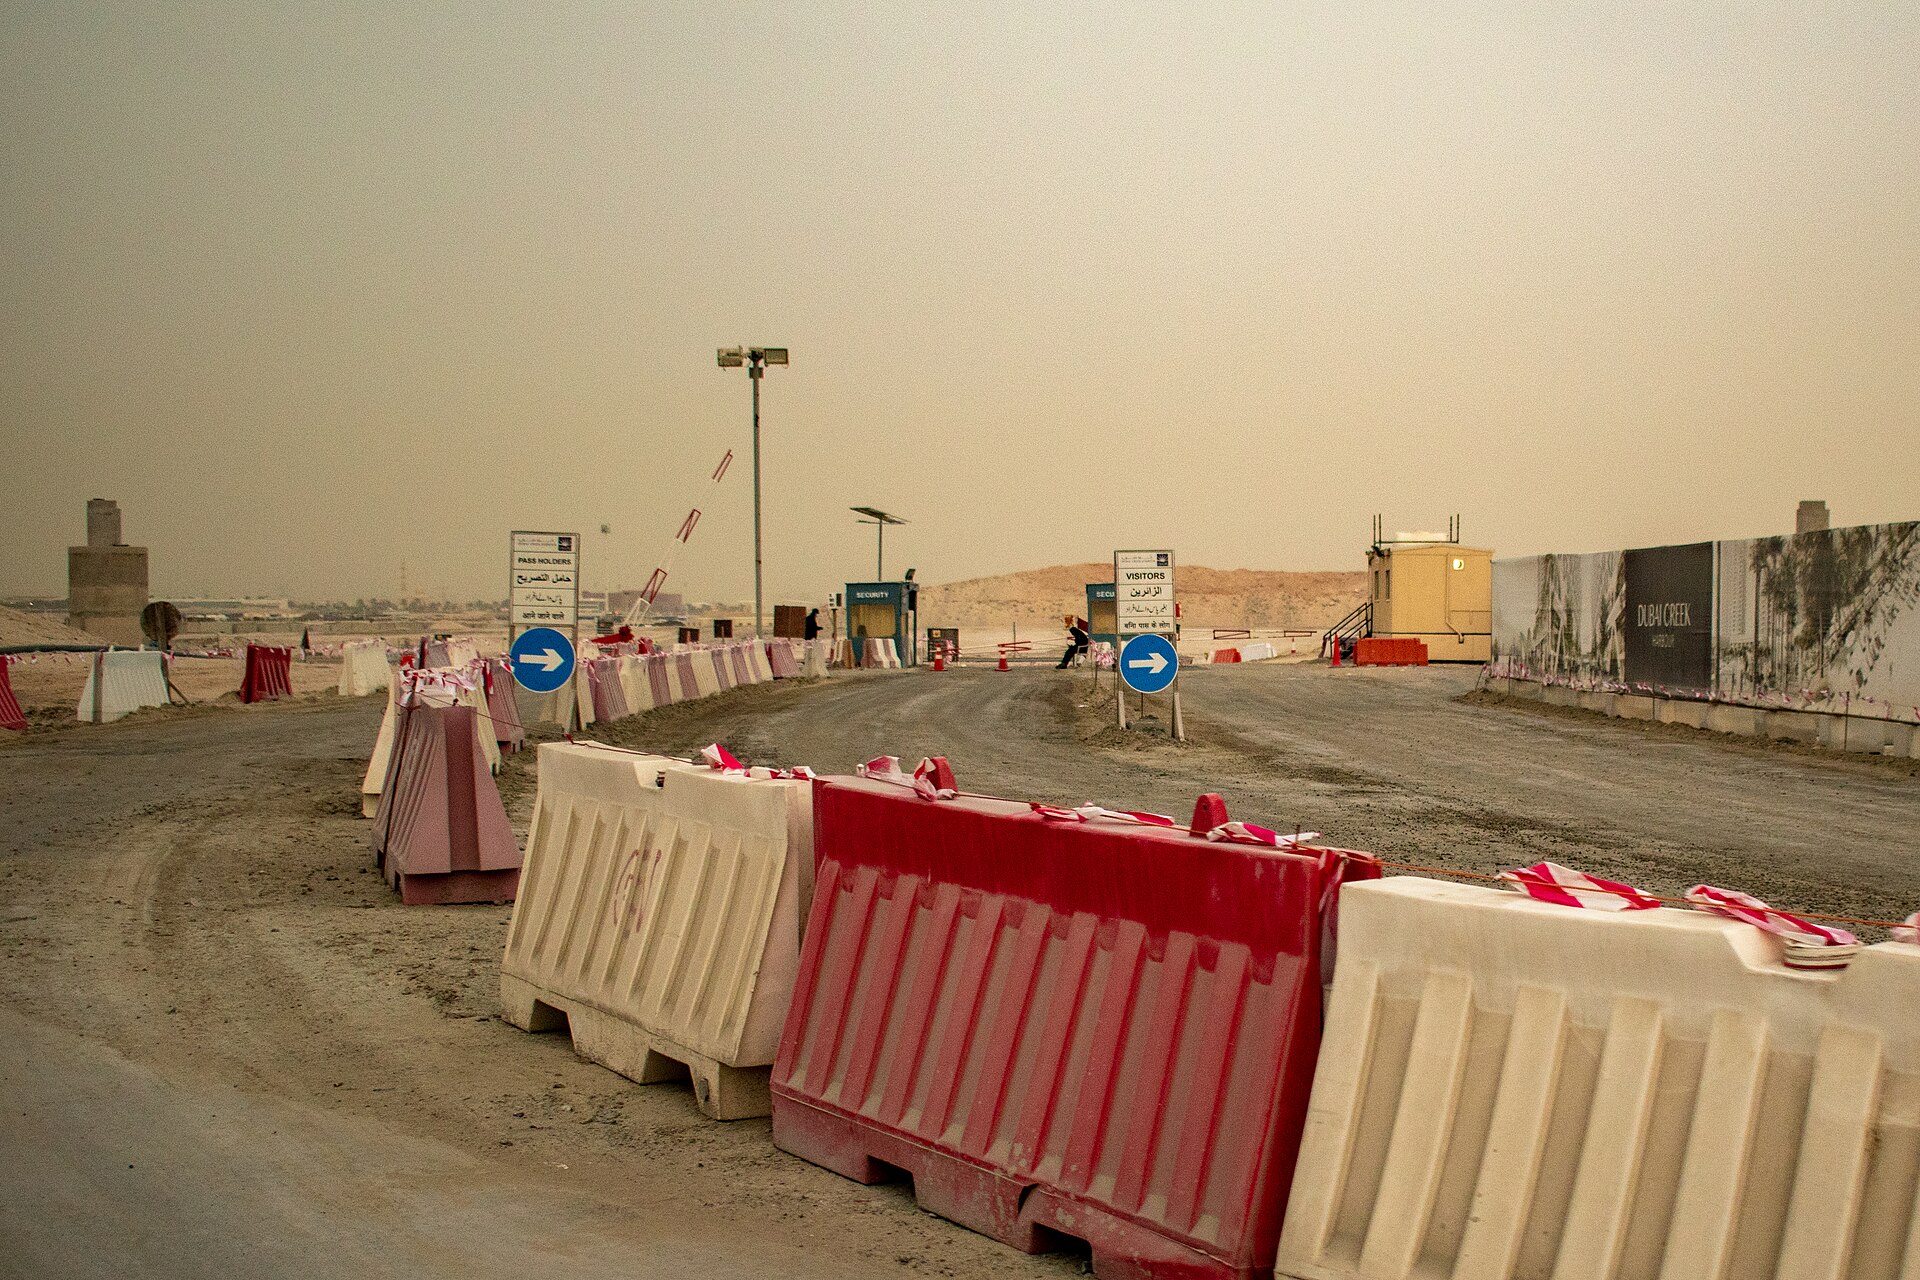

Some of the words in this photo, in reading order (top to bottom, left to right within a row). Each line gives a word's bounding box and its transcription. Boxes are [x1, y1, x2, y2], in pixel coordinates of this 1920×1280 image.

[518, 557, 536, 565] PASS
[517, 573, 550, 585] التصريح
[552, 574, 572, 583] حامل
[1126, 572, 1165, 580] VISITORS
[856, 591, 889, 599] SECURITY
[1130, 586, 1162, 597] الزائرين
[1637, 604, 1662, 627] DUBAI
[1663, 603, 1692, 627] CREEK
